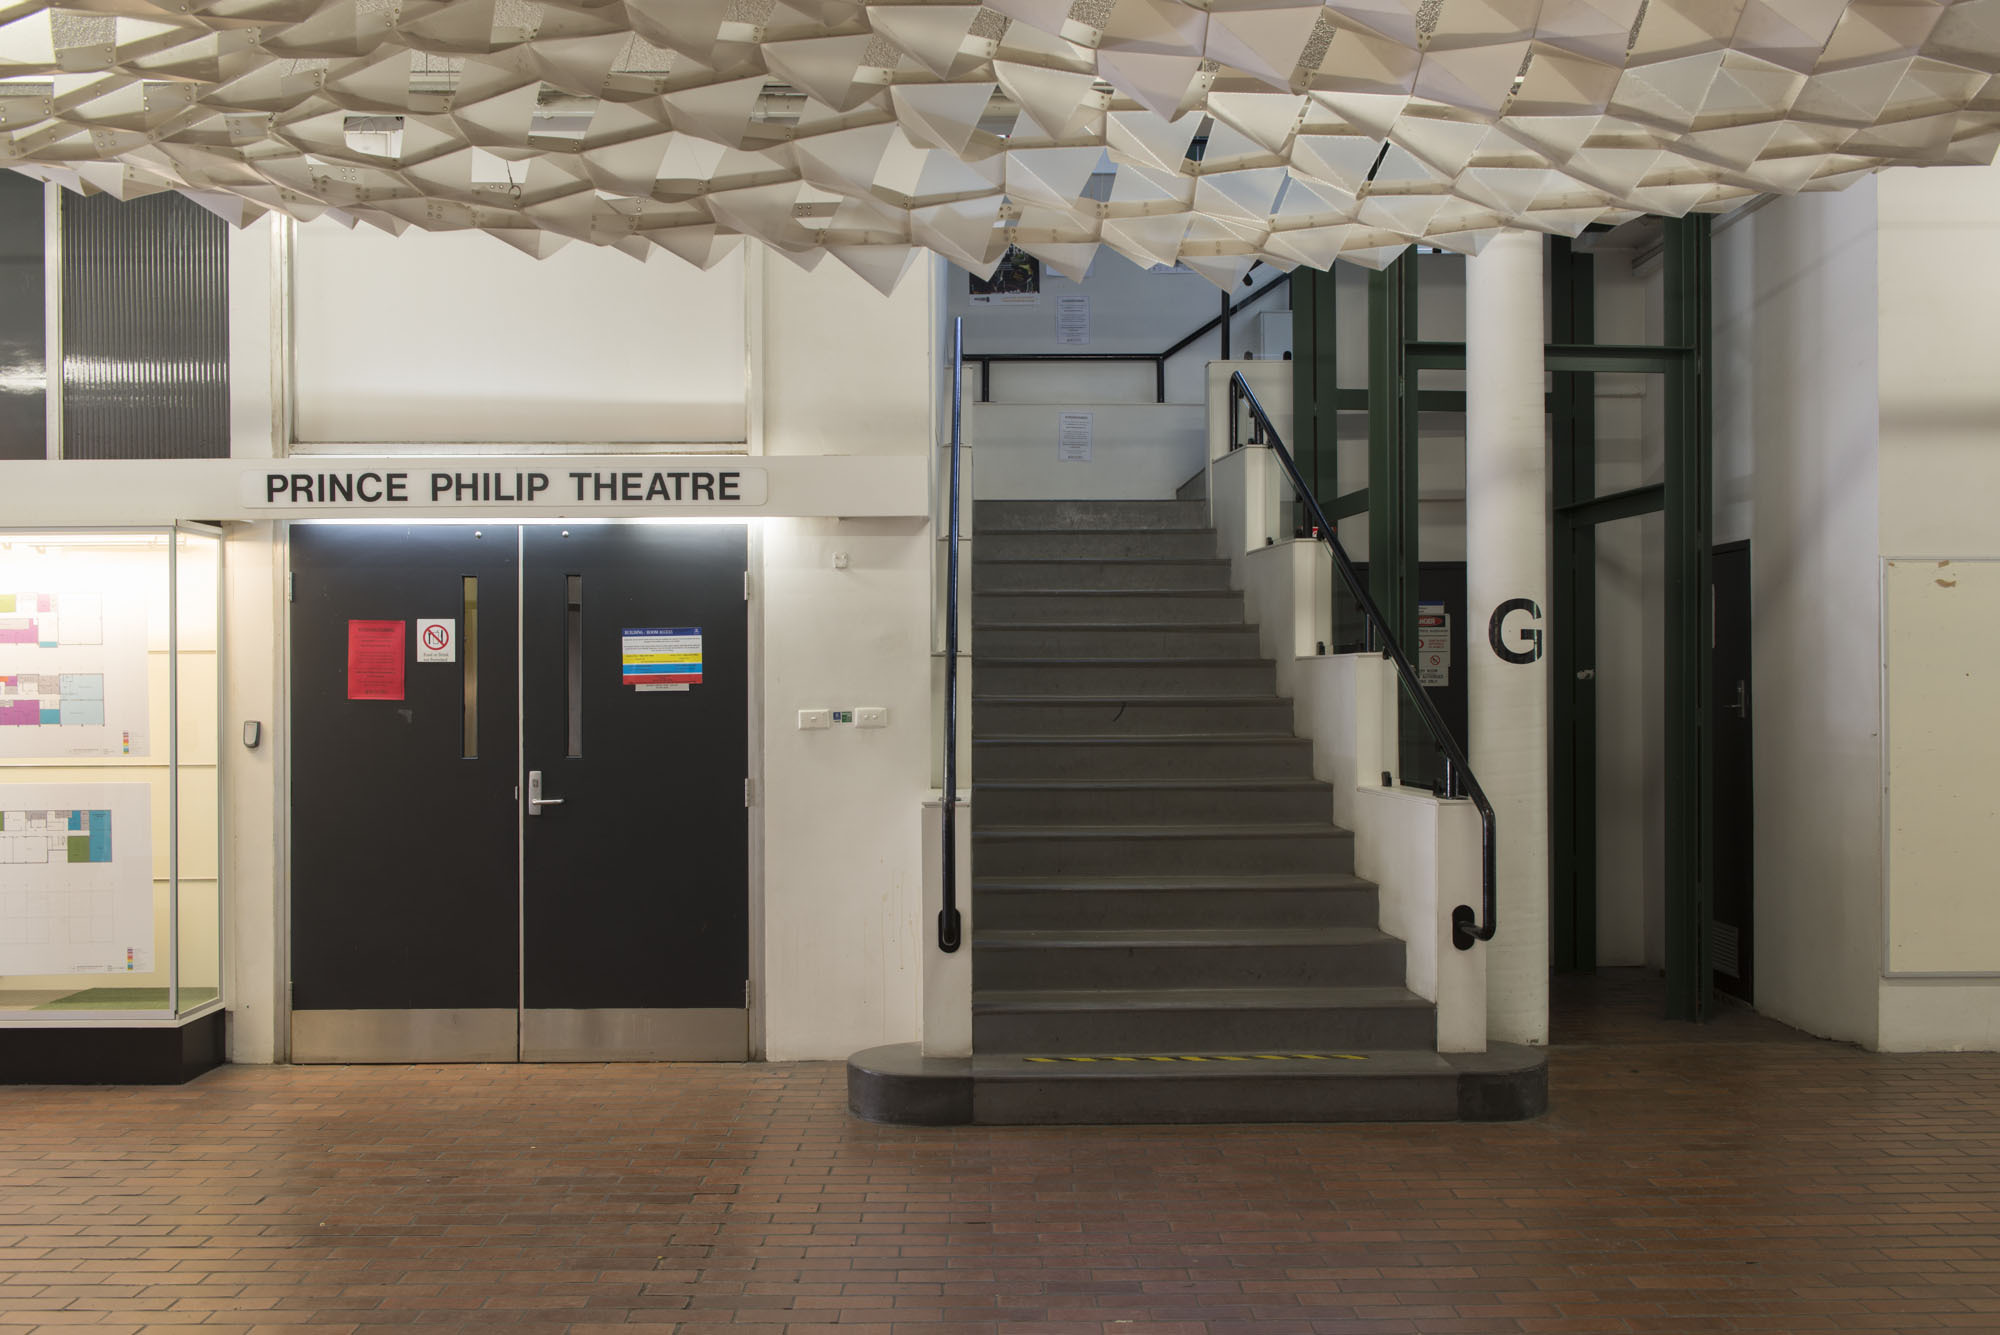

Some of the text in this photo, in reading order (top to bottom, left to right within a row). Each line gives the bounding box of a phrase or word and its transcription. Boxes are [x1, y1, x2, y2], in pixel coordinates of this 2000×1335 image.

[267, 472, 741, 503] PRINCE PHILIP THEATRE
[1488, 598, 1543, 665] G
